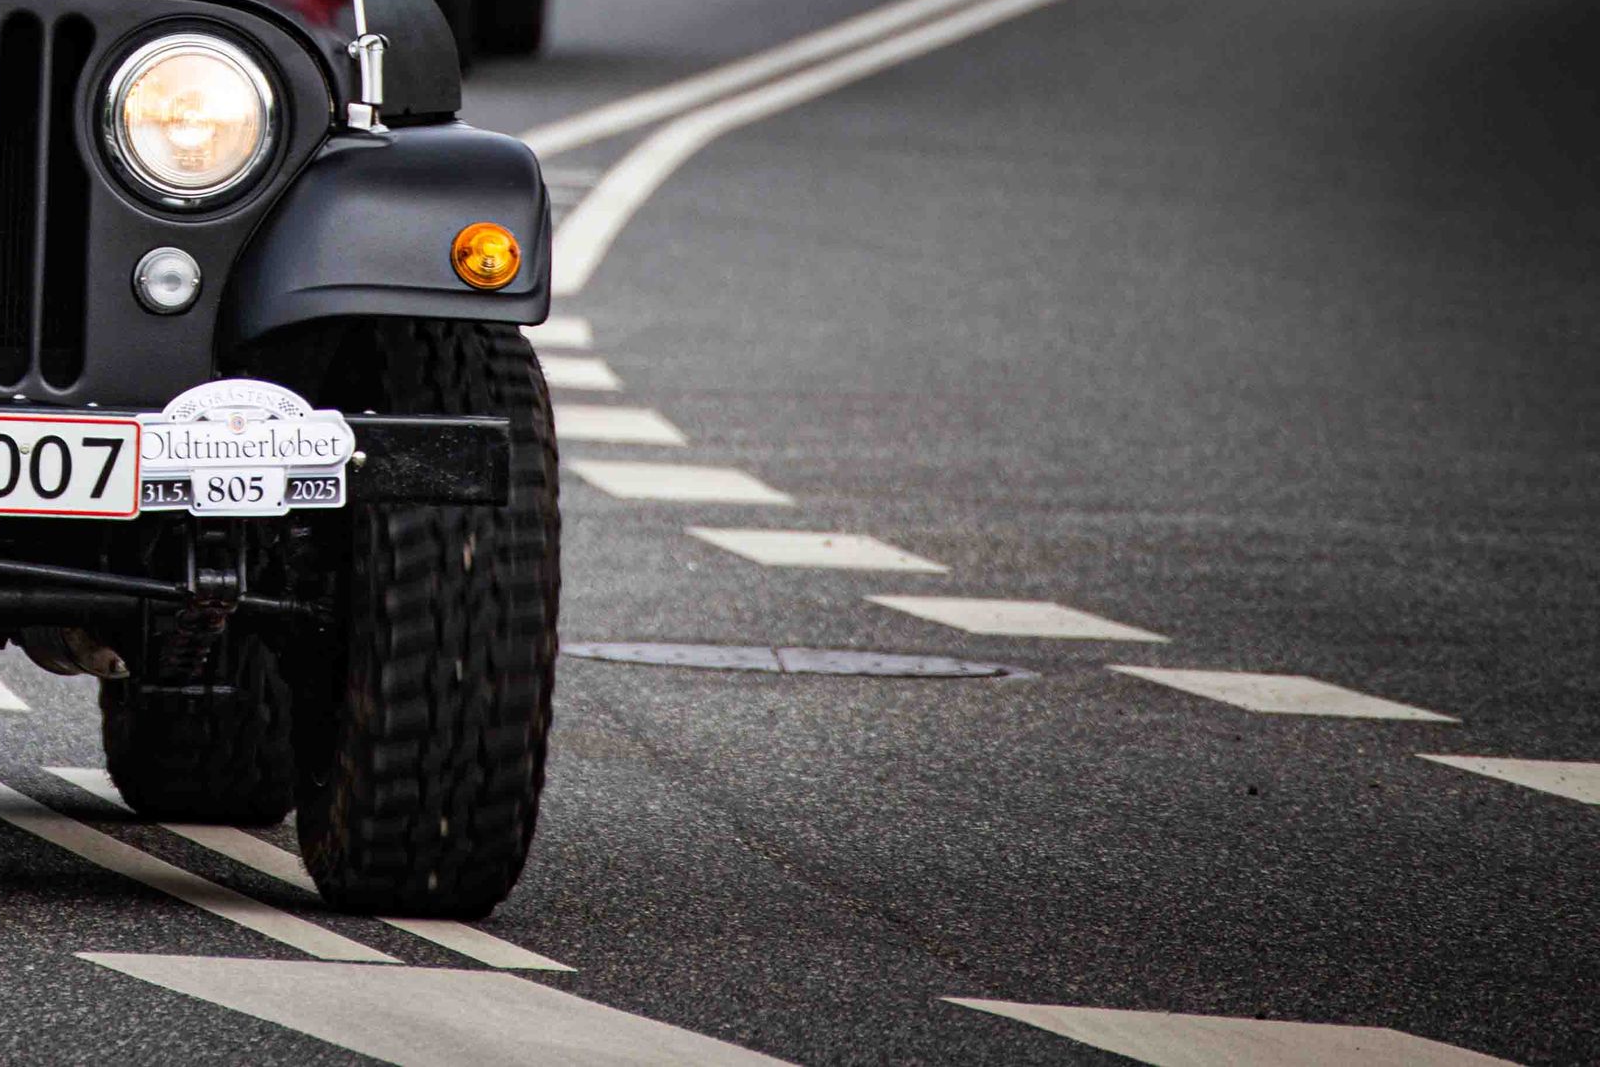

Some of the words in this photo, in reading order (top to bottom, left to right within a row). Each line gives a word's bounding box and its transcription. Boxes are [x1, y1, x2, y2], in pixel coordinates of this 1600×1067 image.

[141, 428, 341, 461] Oldtimerløbet
[207, 476, 264, 503] 805
[291, 480, 337, 500] 2025
